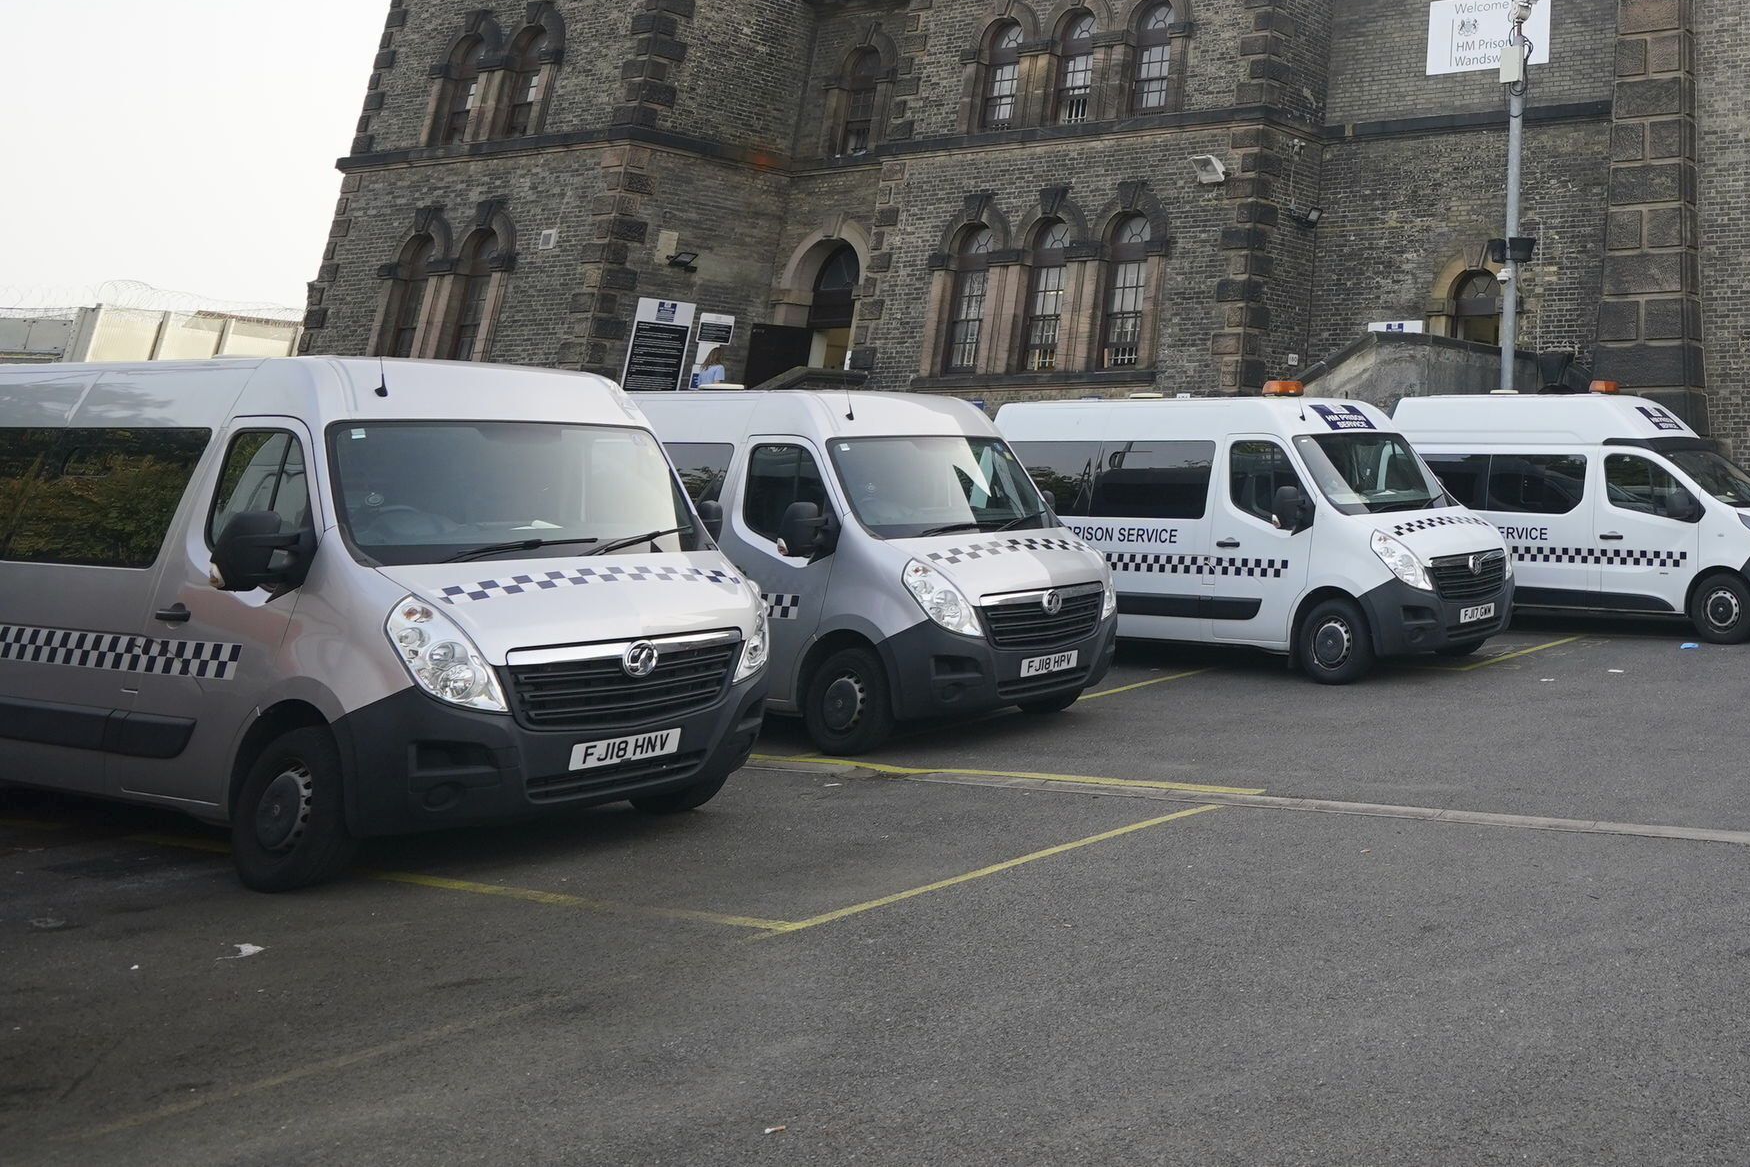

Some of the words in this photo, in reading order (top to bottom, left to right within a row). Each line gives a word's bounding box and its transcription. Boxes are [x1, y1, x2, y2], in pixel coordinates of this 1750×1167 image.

[1454, 1, 1510, 15] Welcome
[1456, 40, 1475, 52] HM
[1117, 527, 1178, 544] SERVICE
[1027, 657, 1051, 673] FJ18
[1053, 653, 1073, 669] HPV
[582, 740, 629, 765] FJ18
[632, 733, 670, 756] HNV
